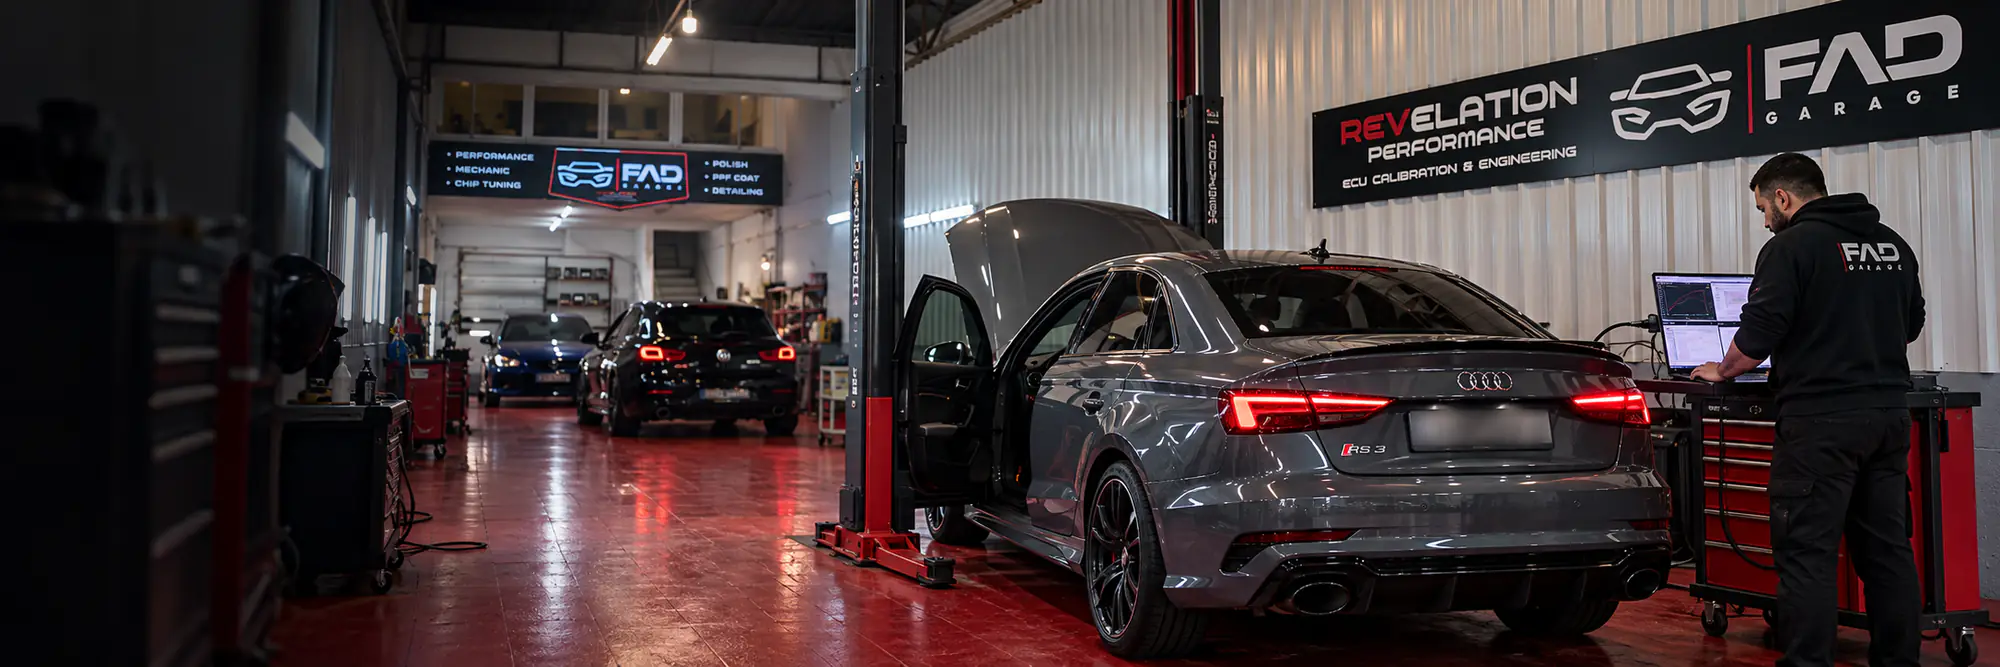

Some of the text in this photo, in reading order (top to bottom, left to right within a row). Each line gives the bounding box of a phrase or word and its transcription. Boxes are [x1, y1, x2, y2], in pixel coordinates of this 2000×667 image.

[1764, 14, 1963, 101] FAD
[1339, 76, 1578, 146] REVELATION
[1765, 84, 1959, 125] GARAGE
[1368, 118, 1544, 163] PERFORMANCE
[455, 151, 535, 161] PERFORMANCE
[455, 165, 510, 175] MECHANIC
[712, 160, 749, 169] POLISH
[1342, 145, 1577, 189] ECU CALIBRATION & ENGINEERING
[622, 163, 683, 184] FAD
[733, 174, 760, 182] COAT
[454, 180, 522, 189] CHIP TUNING
[712, 187, 764, 196] DETAILING
[1841, 242, 1900, 262] FAD
[1346, 444, 1386, 455] RS 3
